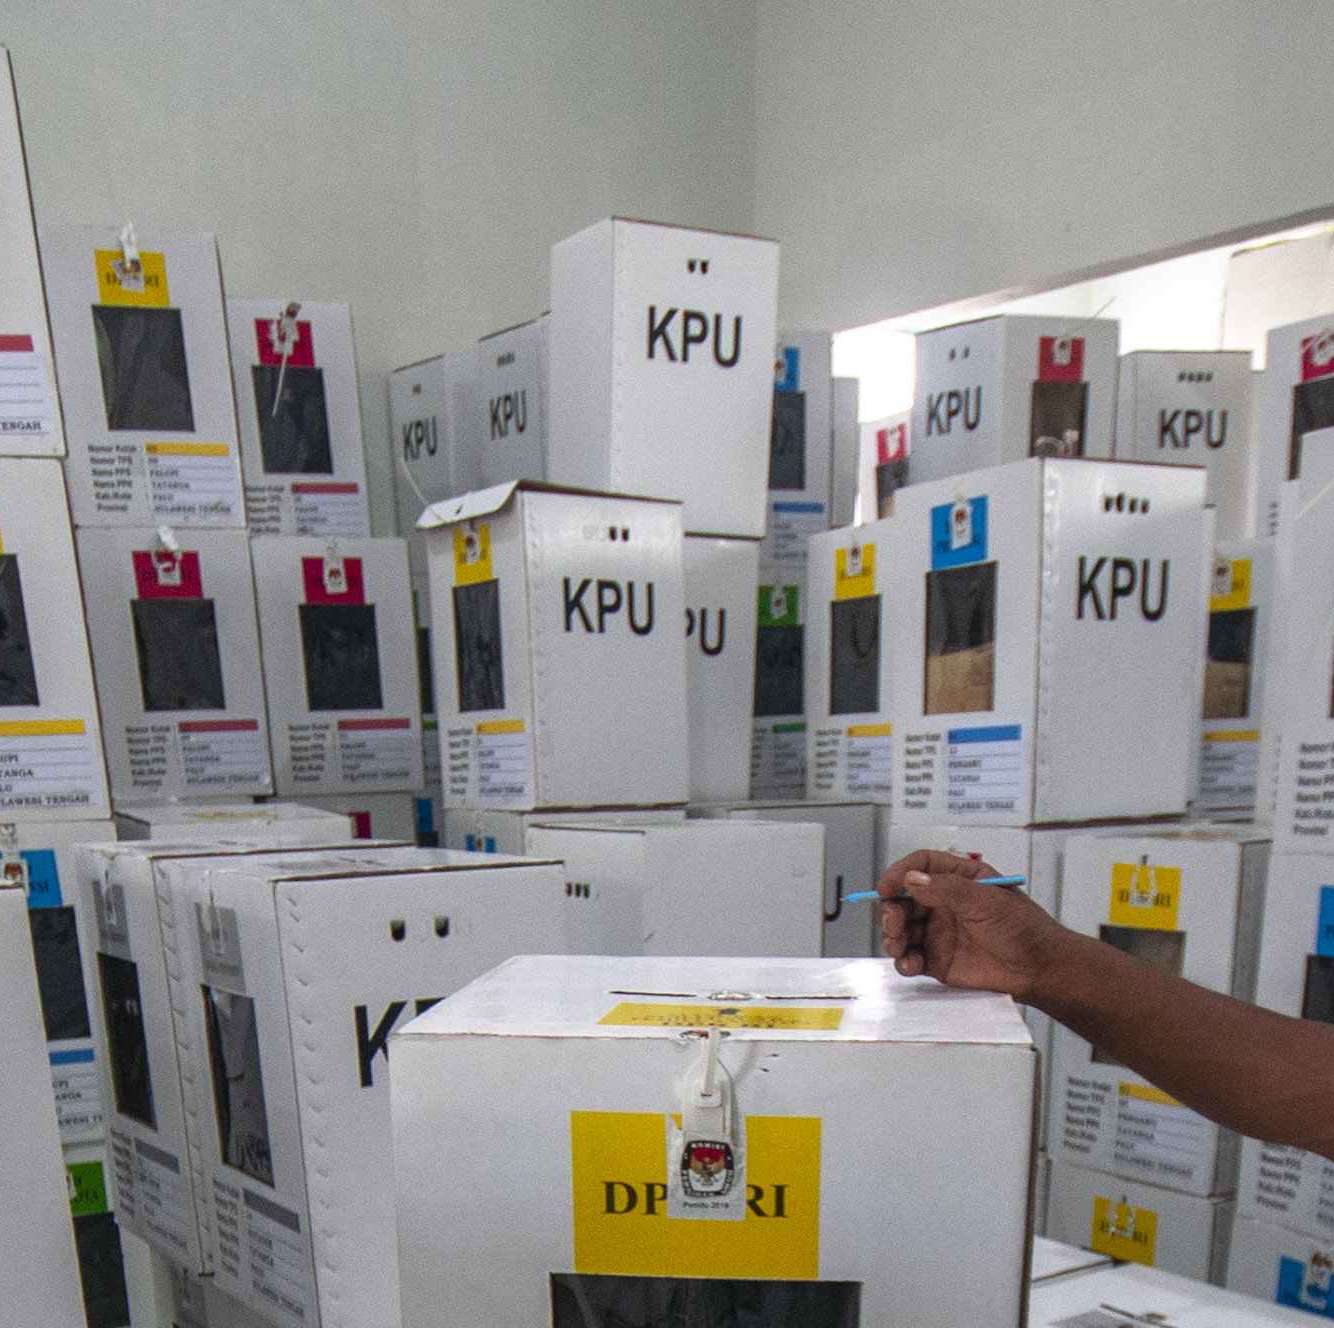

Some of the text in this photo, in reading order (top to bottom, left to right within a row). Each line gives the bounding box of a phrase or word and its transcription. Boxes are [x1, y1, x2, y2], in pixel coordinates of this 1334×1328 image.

[646, 304, 743, 369] KPU
[490, 390, 528, 441] KPU
[926, 385, 983, 438] KPU
[1158, 407, 1229, 450] KPU
[402, 415, 438, 462] KPU
[563, 575, 656, 636] KPU
[1076, 555, 1169, 624] KPU
[600, 1179, 668, 1216] DP
